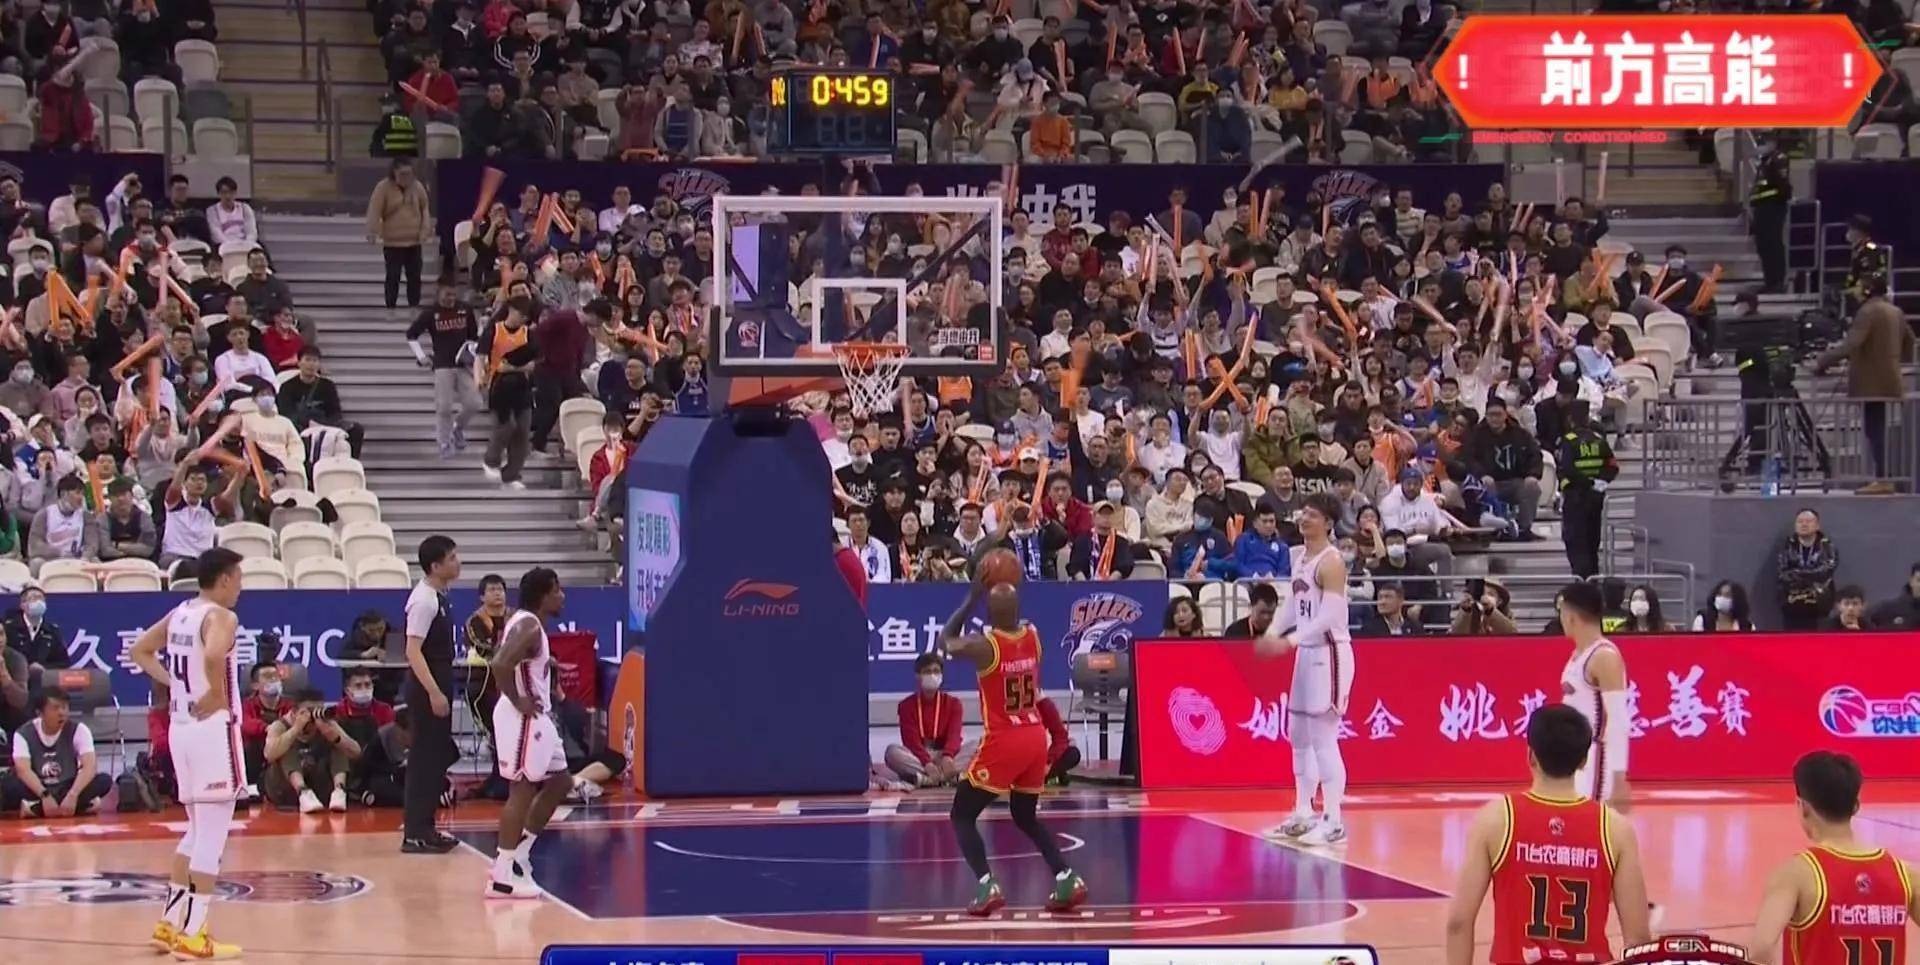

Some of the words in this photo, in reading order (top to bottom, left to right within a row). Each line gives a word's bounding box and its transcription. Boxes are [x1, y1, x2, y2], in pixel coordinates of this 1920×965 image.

[723, 603, 800, 617] LI-NING
[1070, 600, 1143, 633] SHARKS
[1004, 673, 1035, 713] 55
[1516, 841, 1598, 868] 九台农商银行
[1525, 873, 1590, 944] 13
[1830, 904, 1906, 925] 九台农商银行
